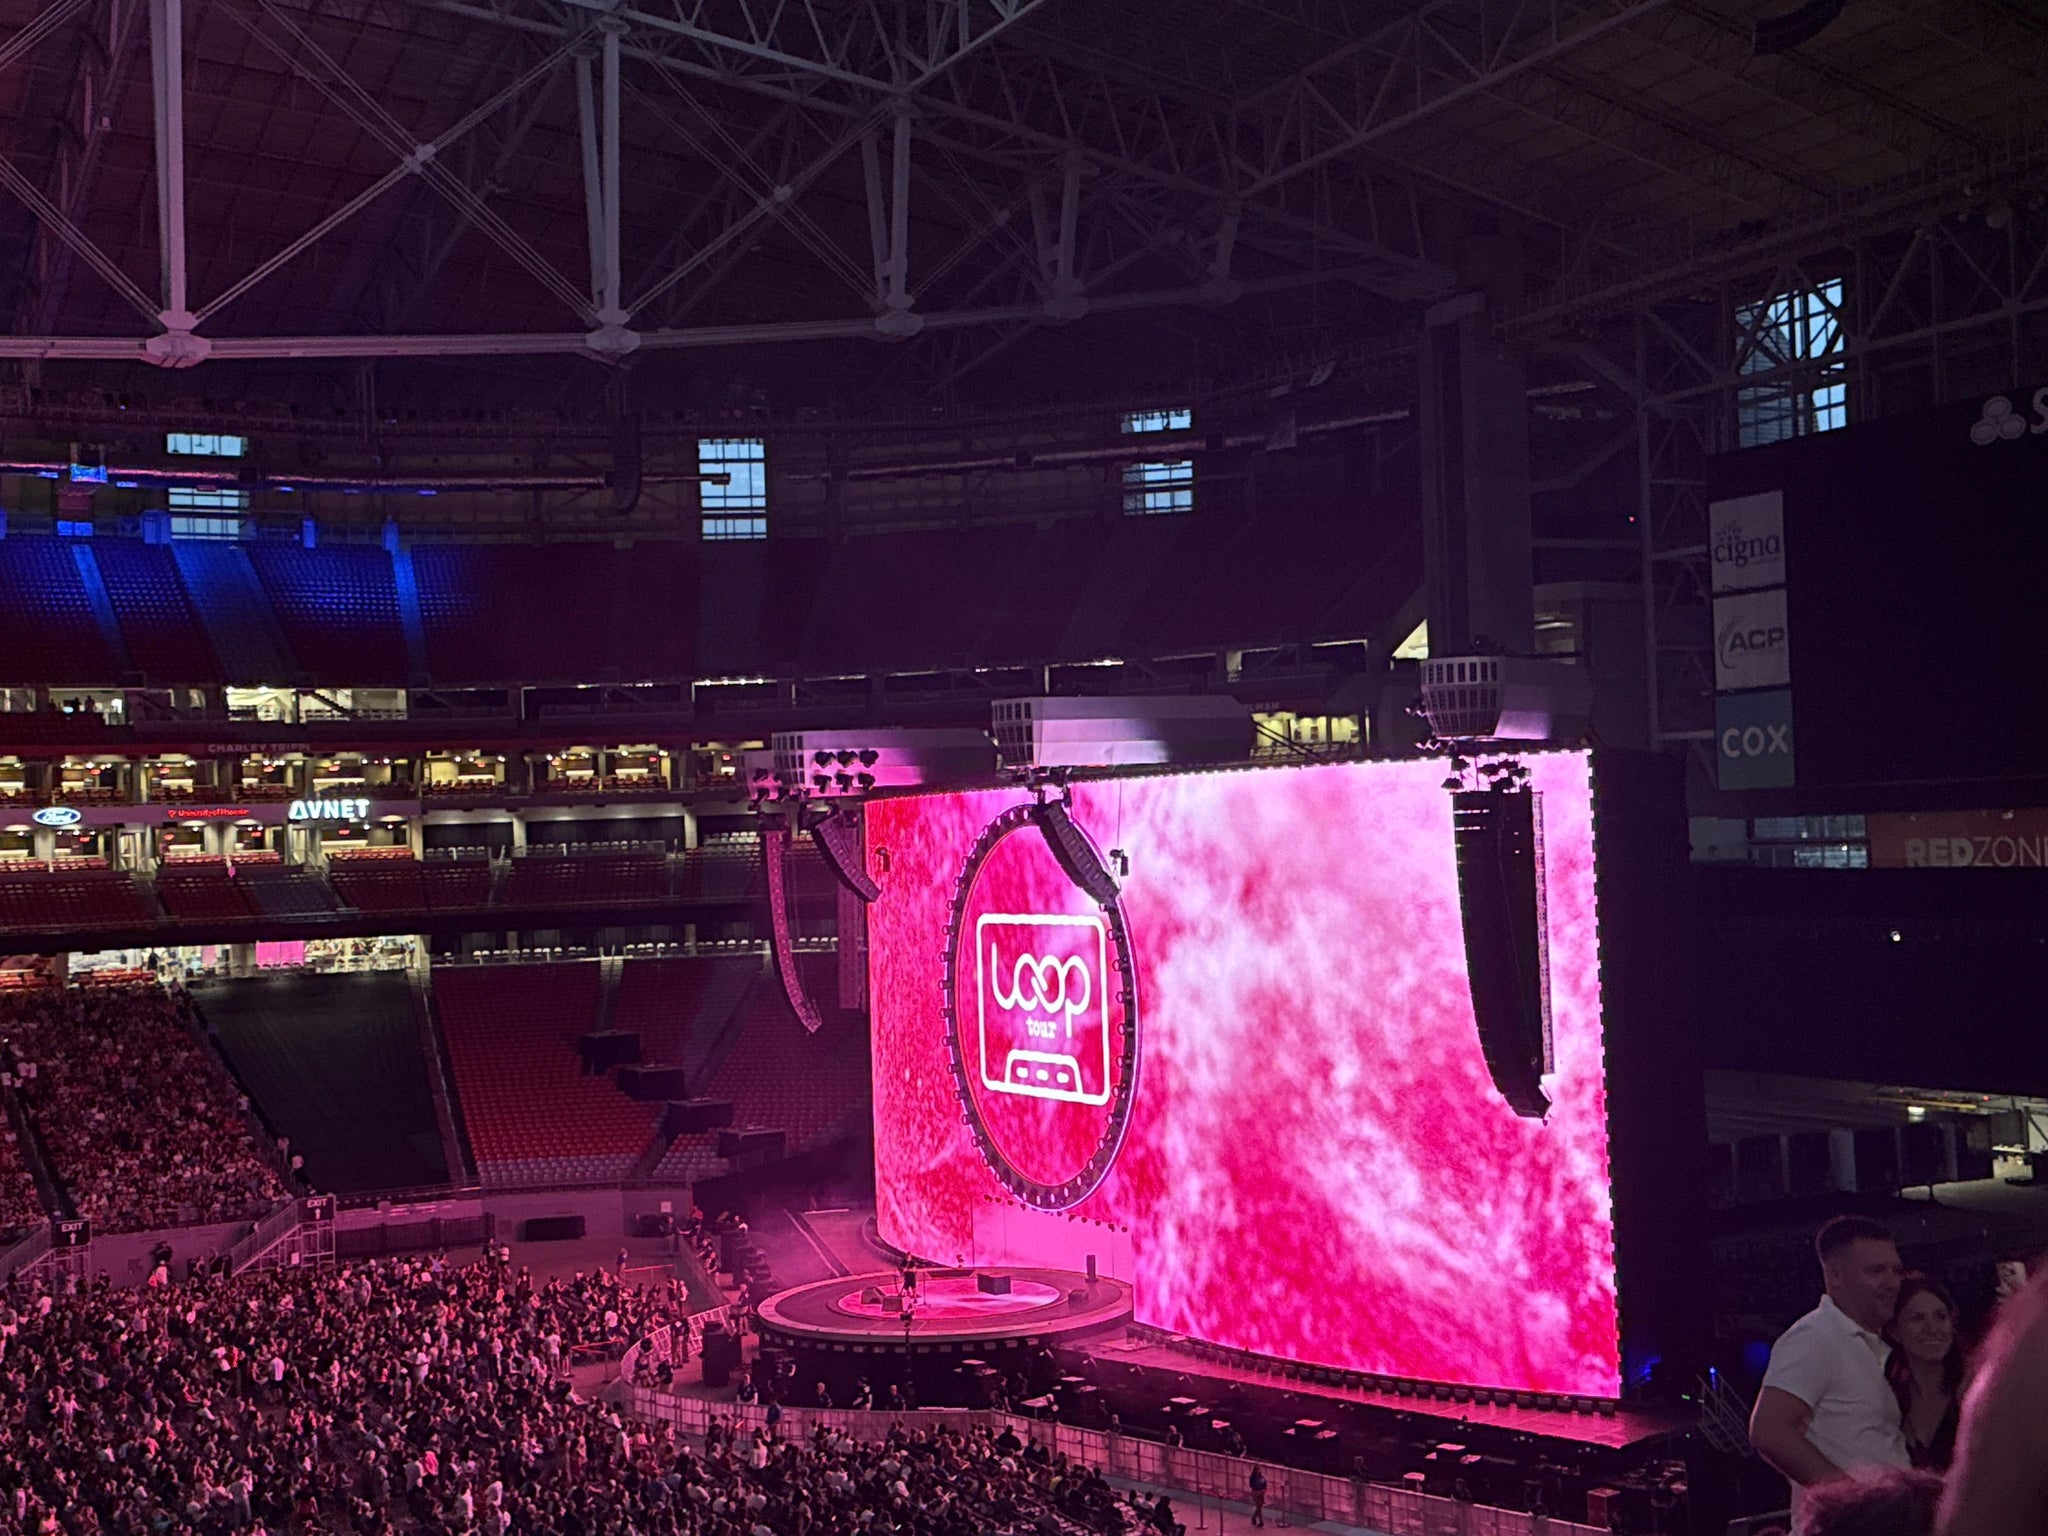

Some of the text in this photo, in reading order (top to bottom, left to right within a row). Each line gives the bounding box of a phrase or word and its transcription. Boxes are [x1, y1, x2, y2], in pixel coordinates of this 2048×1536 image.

[1714, 534, 1781, 568] cigna
[1729, 626, 1785, 652] ACP
[208, 743, 267, 753] CHARLEY
[1722, 724, 1788, 758] COX
[288, 799, 370, 820] AVNET
[1904, 836, 2048, 868] REDZON
[1025, 1015, 1057, 1039] tour
[307, 1198, 327, 1208] EXIT
[61, 1221, 83, 1232] EXIT
